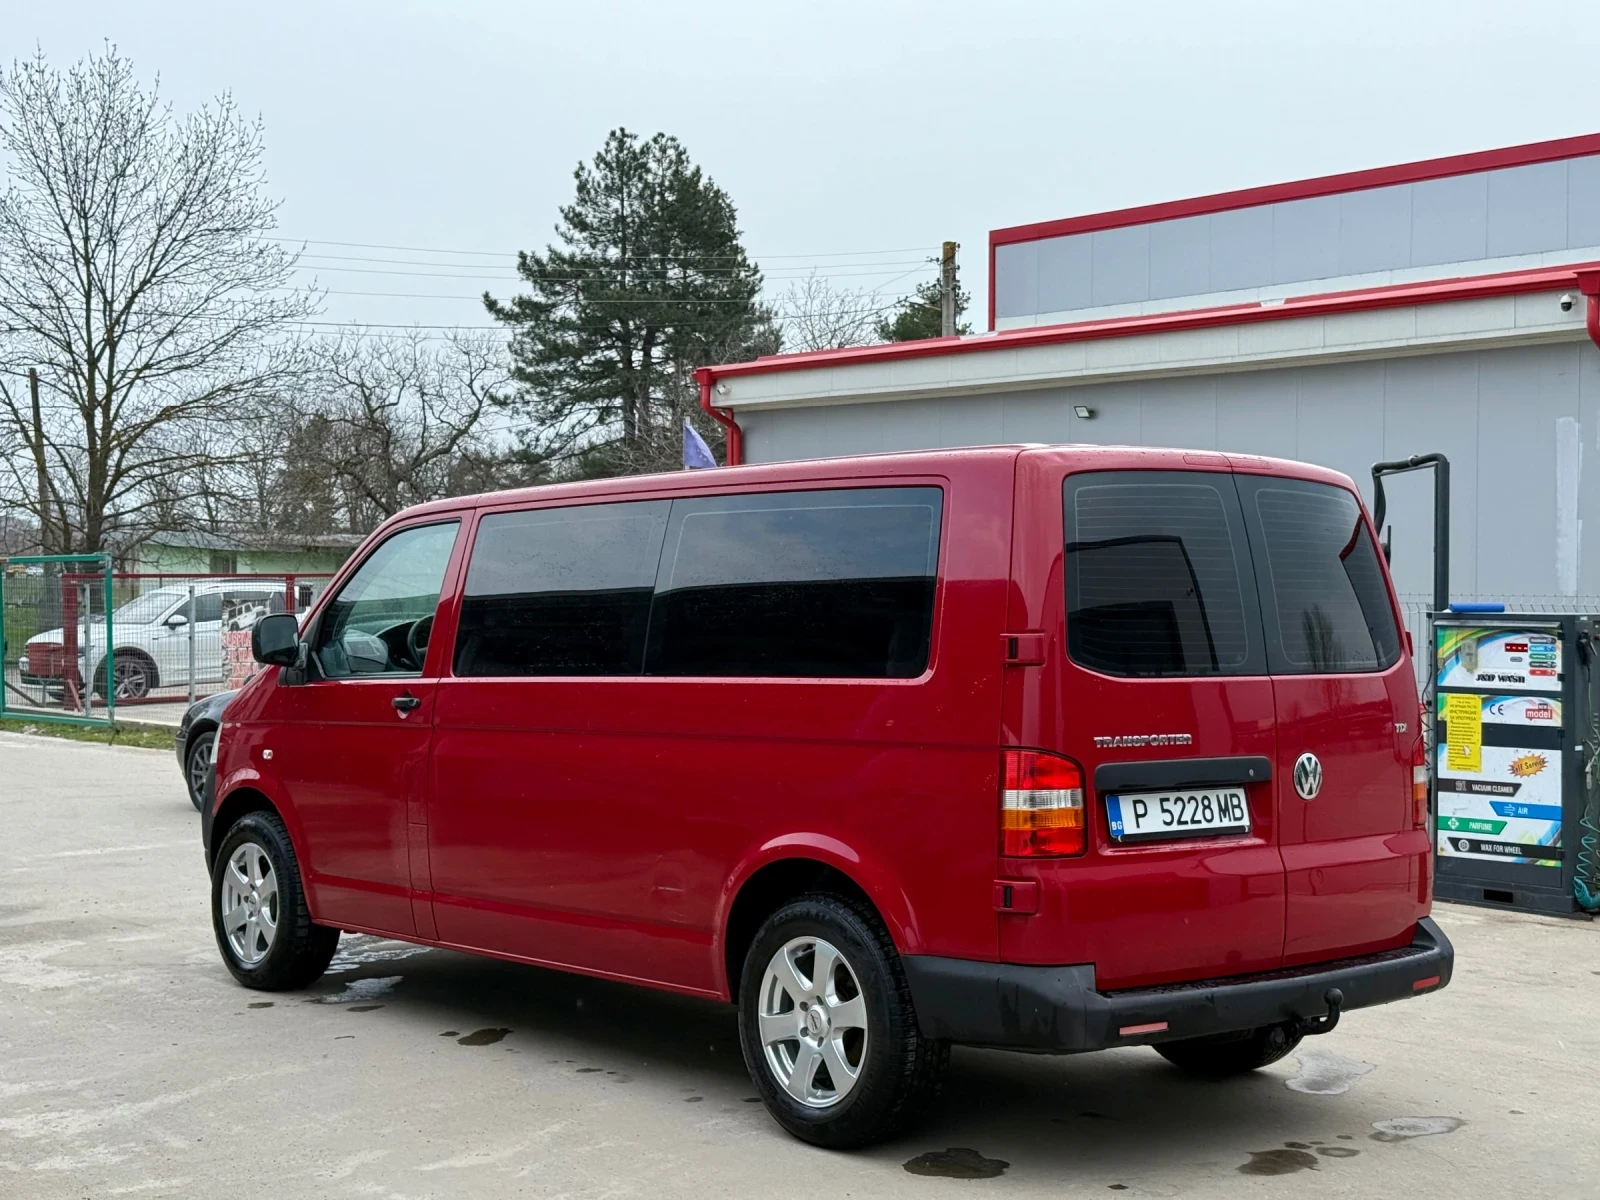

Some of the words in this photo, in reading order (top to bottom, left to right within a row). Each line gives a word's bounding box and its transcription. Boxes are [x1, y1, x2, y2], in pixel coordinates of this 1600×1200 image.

[1497, 674, 1526, 683] WASH
[1489, 704, 1504, 715] CE
[1526, 710, 1551, 718] model
[1093, 734, 1192, 748] TRANSPORTER
[1524, 759, 1546, 770] Service
[1471, 784, 1492, 792] VACUUM
[1492, 785, 1514, 793] CLEANER
[1517, 807, 1528, 815] AIR
[1111, 821, 1123, 831] BG
[1468, 821, 1493, 831] PARFUME
[1480, 843, 1493, 852] WAX
[1493, 844, 1504, 853] FOR
[1504, 845, 1522, 855] WHEEL
